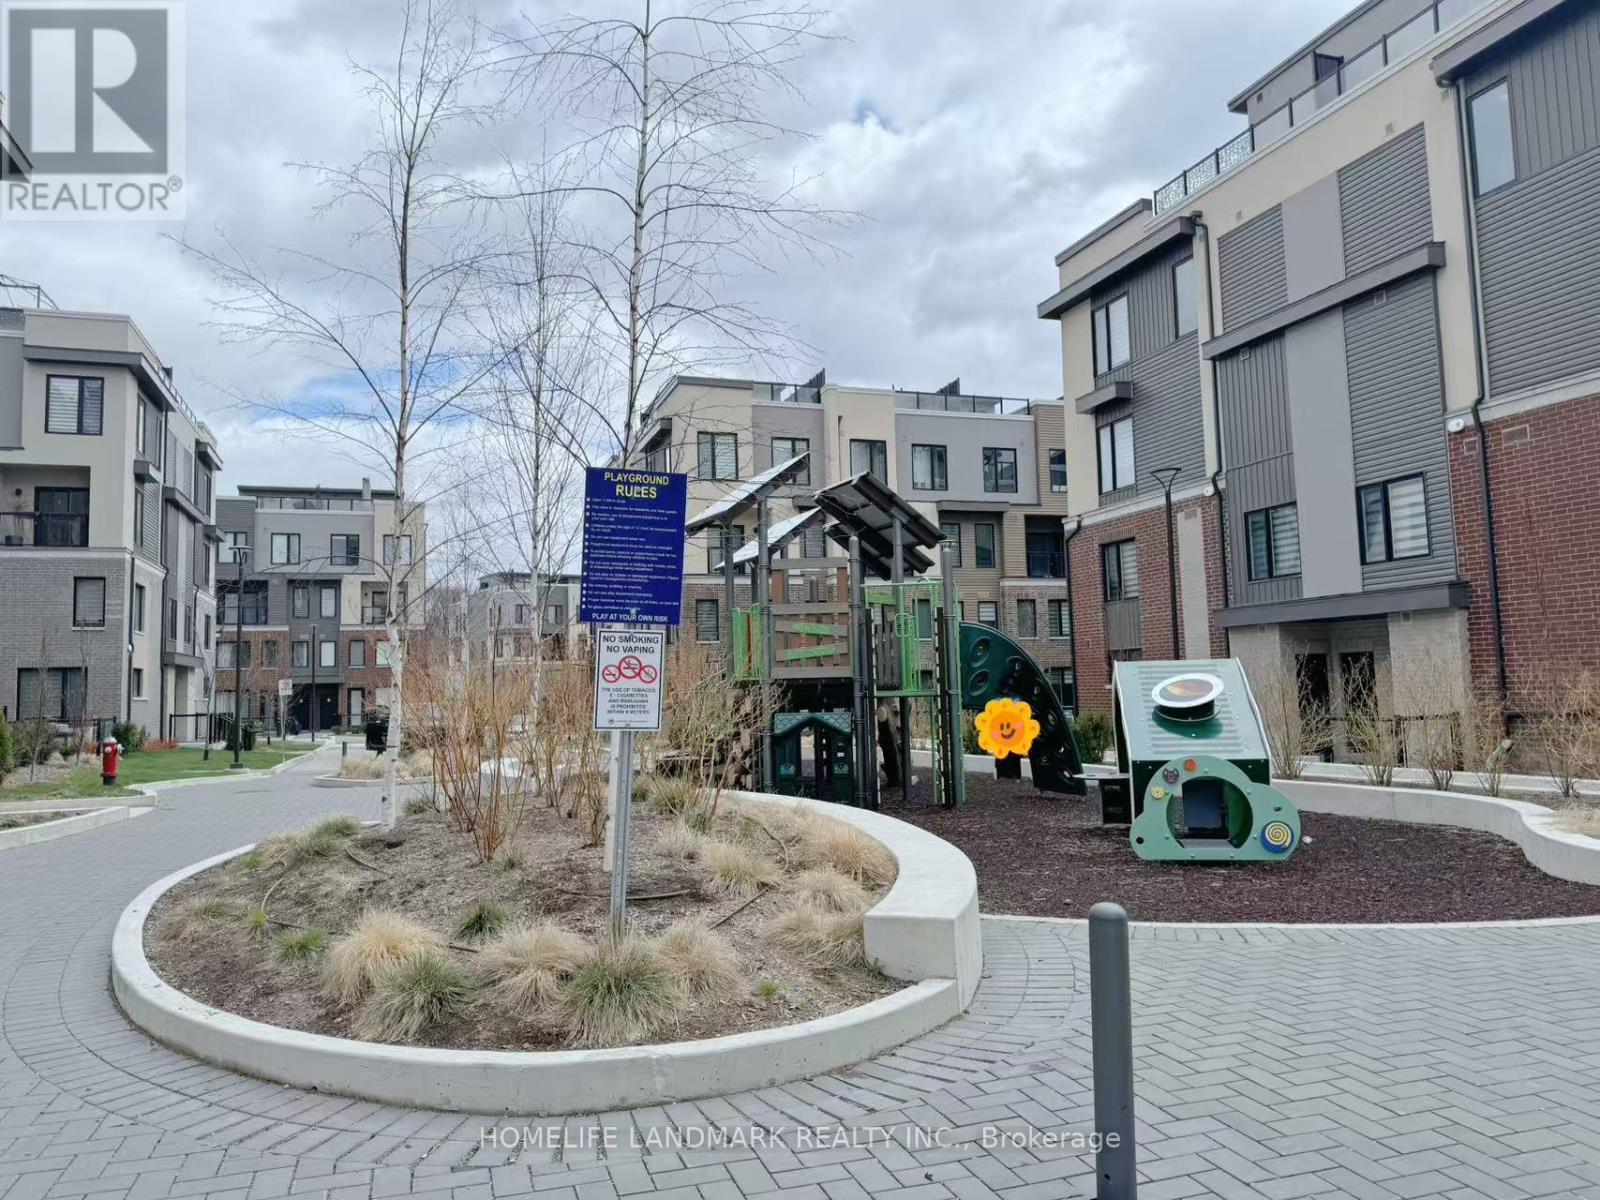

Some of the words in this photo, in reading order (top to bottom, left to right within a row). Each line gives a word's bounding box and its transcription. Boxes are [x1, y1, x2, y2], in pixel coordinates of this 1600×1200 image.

[604, 471, 669, 486] PLAYGROUND
[616, 484, 657, 499] RULES
[592, 612, 609, 620] PLAY
[618, 613, 637, 621] YOUR
[637, 614, 653, 622] OWN
[653, 615, 669, 623] RISK
[603, 635, 616, 643] NO
[619, 635, 660, 645] SMOKING
[606, 645, 620, 653] NO
[622, 645, 655, 654] VAPING
